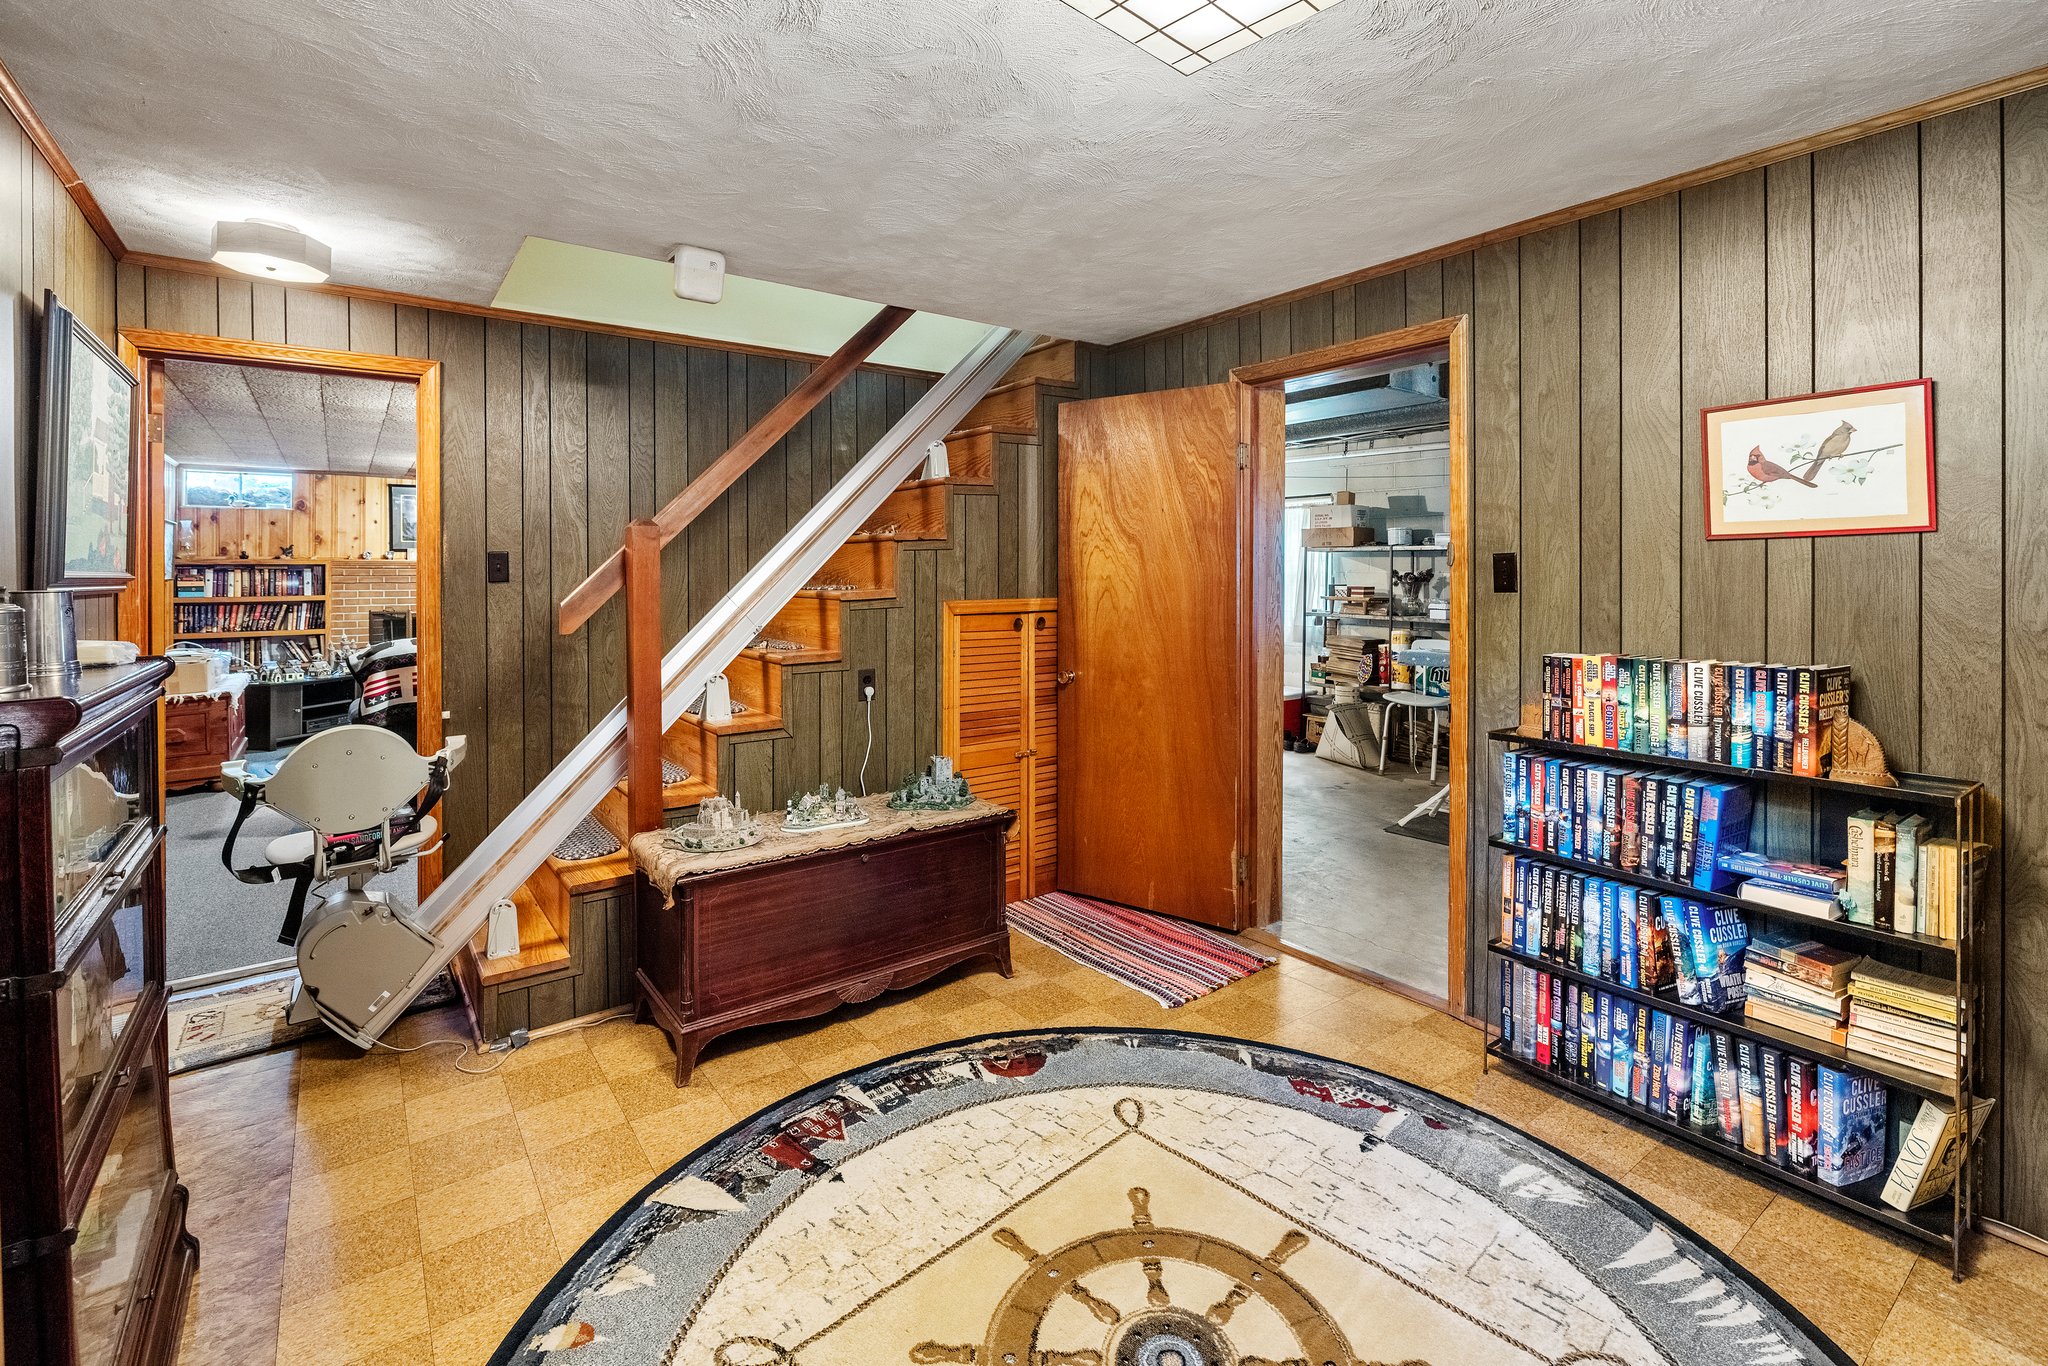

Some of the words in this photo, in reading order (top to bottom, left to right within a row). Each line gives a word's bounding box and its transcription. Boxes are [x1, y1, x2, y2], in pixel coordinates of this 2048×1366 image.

[1652, 663, 1661, 682] CLIVE
[1673, 664, 1683, 686] CLIVE
[1693, 667, 1704, 688] CLIVE
[1714, 667, 1723, 686] CLIVE
[1735, 669, 1745, 688] CLIVE
[1755, 670, 1766, 692] CLIVE
[1777, 672, 1788, 695] CLIVE
[1799, 672, 1810, 694] CLIVE
[1826, 676, 1842, 691] CLIVE
[1673, 687, 1683, 720] CUSSLER
[1693, 690, 1703, 725] CUSSLER
[1714, 687, 1723, 716] CUSSLER
[1755, 693, 1766, 727] CUSSLER
[1777, 696, 1787, 731] CUSSLER
[1799, 694, 1809, 734] CUSSLER'S
[1650, 714, 1659, 748] MIRAGE
[1670, 723, 1680, 752] PIRANHA
[1714, 724, 1722, 748] TYPHOON
[1756, 736, 1764, 749] FINAL
[1714, 748, 1722, 762] FURY
[1756, 750, 1764, 767] OPTION
[1576, 770, 1584, 787] CLIVE
[1590, 773, 1598, 790] CLIVE
[1607, 777, 1616, 797] CLIVE
[1627, 778, 1636, 800] CLIVE
[1576, 787, 1584, 813] CUSSLER
[1646, 781, 1656, 802] CLIVE
[1666, 785, 1677, 806] CLIVE
[1685, 788, 1695, 809] CLIVE
[1607, 797, 1615, 828] CUSSLER
[1626, 801, 1635, 833] CUSSLER
[1645, 802, 1656, 835] CUSSLER
[1665, 807, 1677, 839] CUSSLER
[1683, 809, 1694, 843] CUSSLER
[351, 831, 382, 845] SANDFOR
[1602, 829, 1611, 860] ASSASSIN
[1705, 841, 1714, 856] THE
[1695, 832, 1706, 869] HUNTERS
[1665, 851, 1674, 875] TITANIC
[1703, 857, 1713, 872] SEA
[1730, 864, 1758, 875] HUNTERS
[1758, 870, 1770, 878] SEA
[1545, 870, 1553, 888] CLIVE
[1769, 872, 1781, 880] THE
[1783, 875, 1810, 886] CUSSLER
[1811, 880, 1829, 890] CLIVE
[1572, 879, 1580, 896] CLIVE
[1603, 887, 1611, 906] CLIVE
[1571, 896, 1579, 925] CUSSLER
[1621, 892, 1629, 912] CLIVE
[1639, 896, 1647, 916] CLIVE
[1663, 900, 1675, 922] CLIVE
[1603, 907, 1611, 938] CUSSLER
[1688, 906, 1700, 928] CLIVE
[1714, 908, 1740, 926] CLIVE
[1541, 926, 1550, 948] TOMBS
[1621, 913, 1630, 944] CUSSLER
[1639, 917, 1648, 949] CUSSLER
[1709, 923, 1748, 943] CUSSLER
[1668, 923, 1682, 957] CUSSLER
[1693, 929, 1706, 964] CUSSLER
[1553, 978, 1561, 996] CLIVE
[1719, 972, 1742, 988] WRATH
[1726, 985, 1746, 1000] POSE
[1857, 991, 1873, 999] PEYTON
[1553, 996, 1561, 1021] CUSSLER
[1601, 997, 1609, 1014] CLIVE
[1600, 1015, 1608, 1041] CUSSLER
[1638, 1008, 1646, 1027] CLIVE
[1657, 1016, 1665, 1033] CLIVE
[1637, 1027, 1645, 1054] CUSSLER
[1674, 1023, 1684, 1042] CLIVE
[1655, 1034, 1664, 1062] CUSSLER
[1716, 1035, 1728, 1057] CLIVE
[1739, 1043, 1751, 1066] CLIVE
[1673, 1043, 1682, 1072] CUSSLER
[1763, 1054, 1775, 1077] CLIVE
[1653, 1064, 1661, 1081] ZERO
[1718, 1057, 1729, 1091] CUSSLER
[1790, 1062, 1801, 1086] CLIVE
[1652, 1081, 1661, 1099] HOUR
[1740, 1067, 1752, 1103] CUSSLER
[1823, 1072, 1834, 1097] CLIVE
[1851, 1077, 1879, 1096] CLIVE
[1667, 1094, 1678, 1111] SHIP
[1765, 1078, 1777, 1116] CUSSLER
[1791, 1086, 1801, 1124] CUSSLER
[1843, 1089, 1887, 1115] CUSSLER
[1823, 1097, 1834, 1134] CUSSLER
[1844, 1151, 1866, 1172] FAST
[1866, 1148, 1883, 1164] ICE
[1891, 1127, 1930, 1193] SONYA
